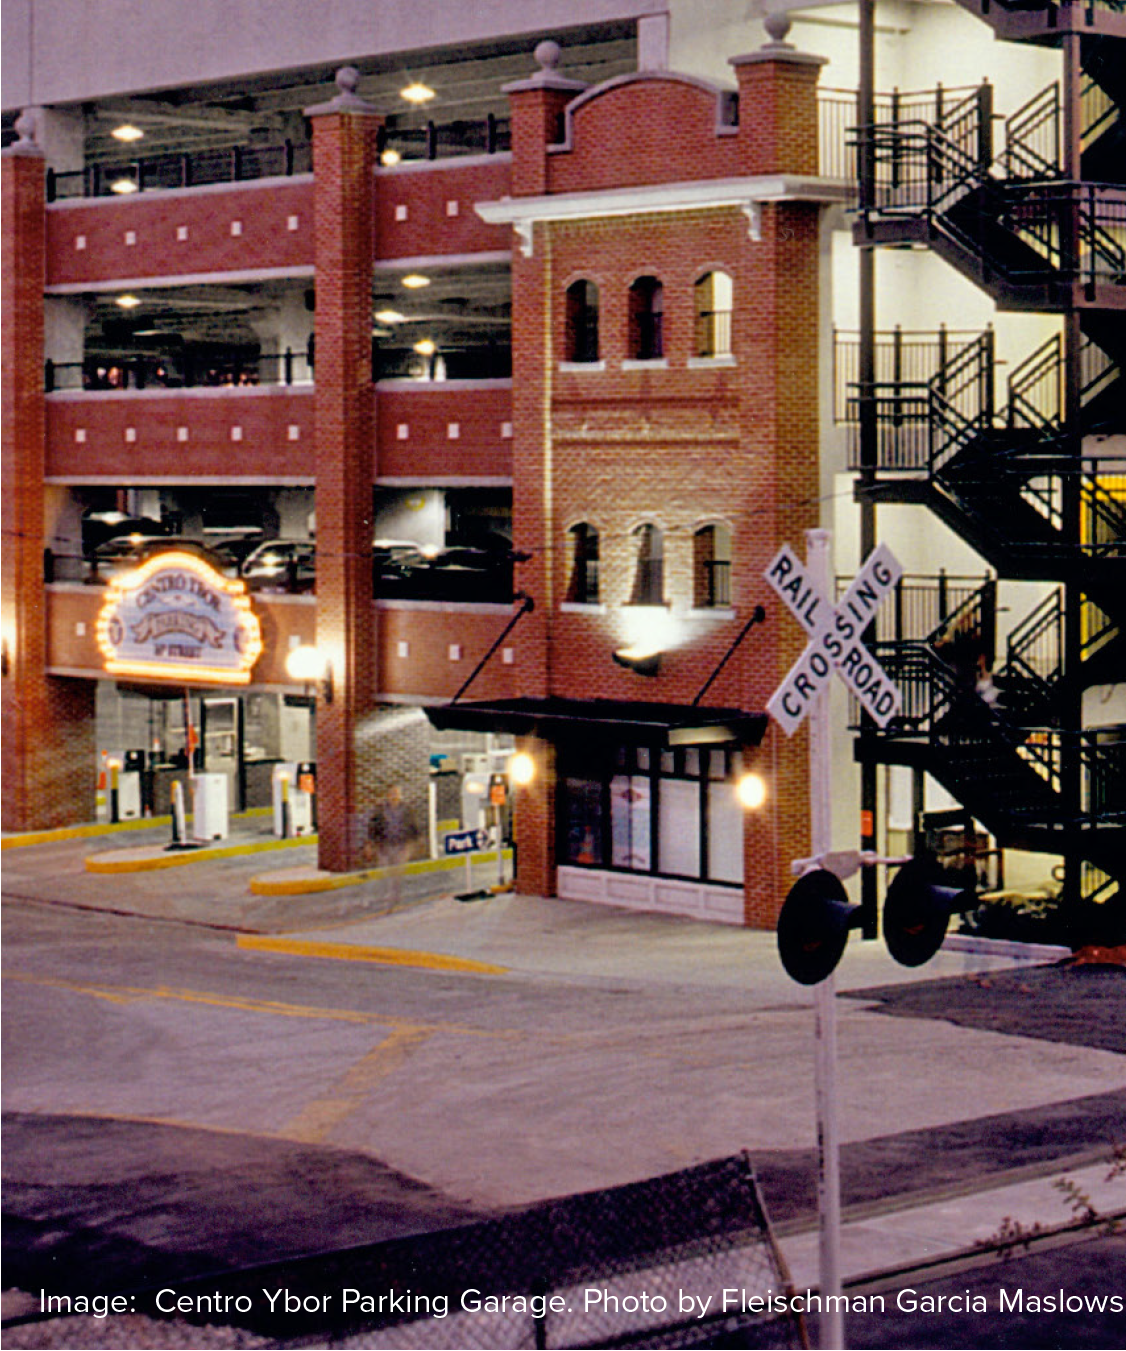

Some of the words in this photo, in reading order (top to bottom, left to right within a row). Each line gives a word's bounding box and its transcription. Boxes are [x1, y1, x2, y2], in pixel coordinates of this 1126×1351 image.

[770, 555, 820, 628] RAIL
[842, 648, 894, 717] ROAD
[781, 561, 892, 717] CROSSING
[449, 835, 473, 851] Park
